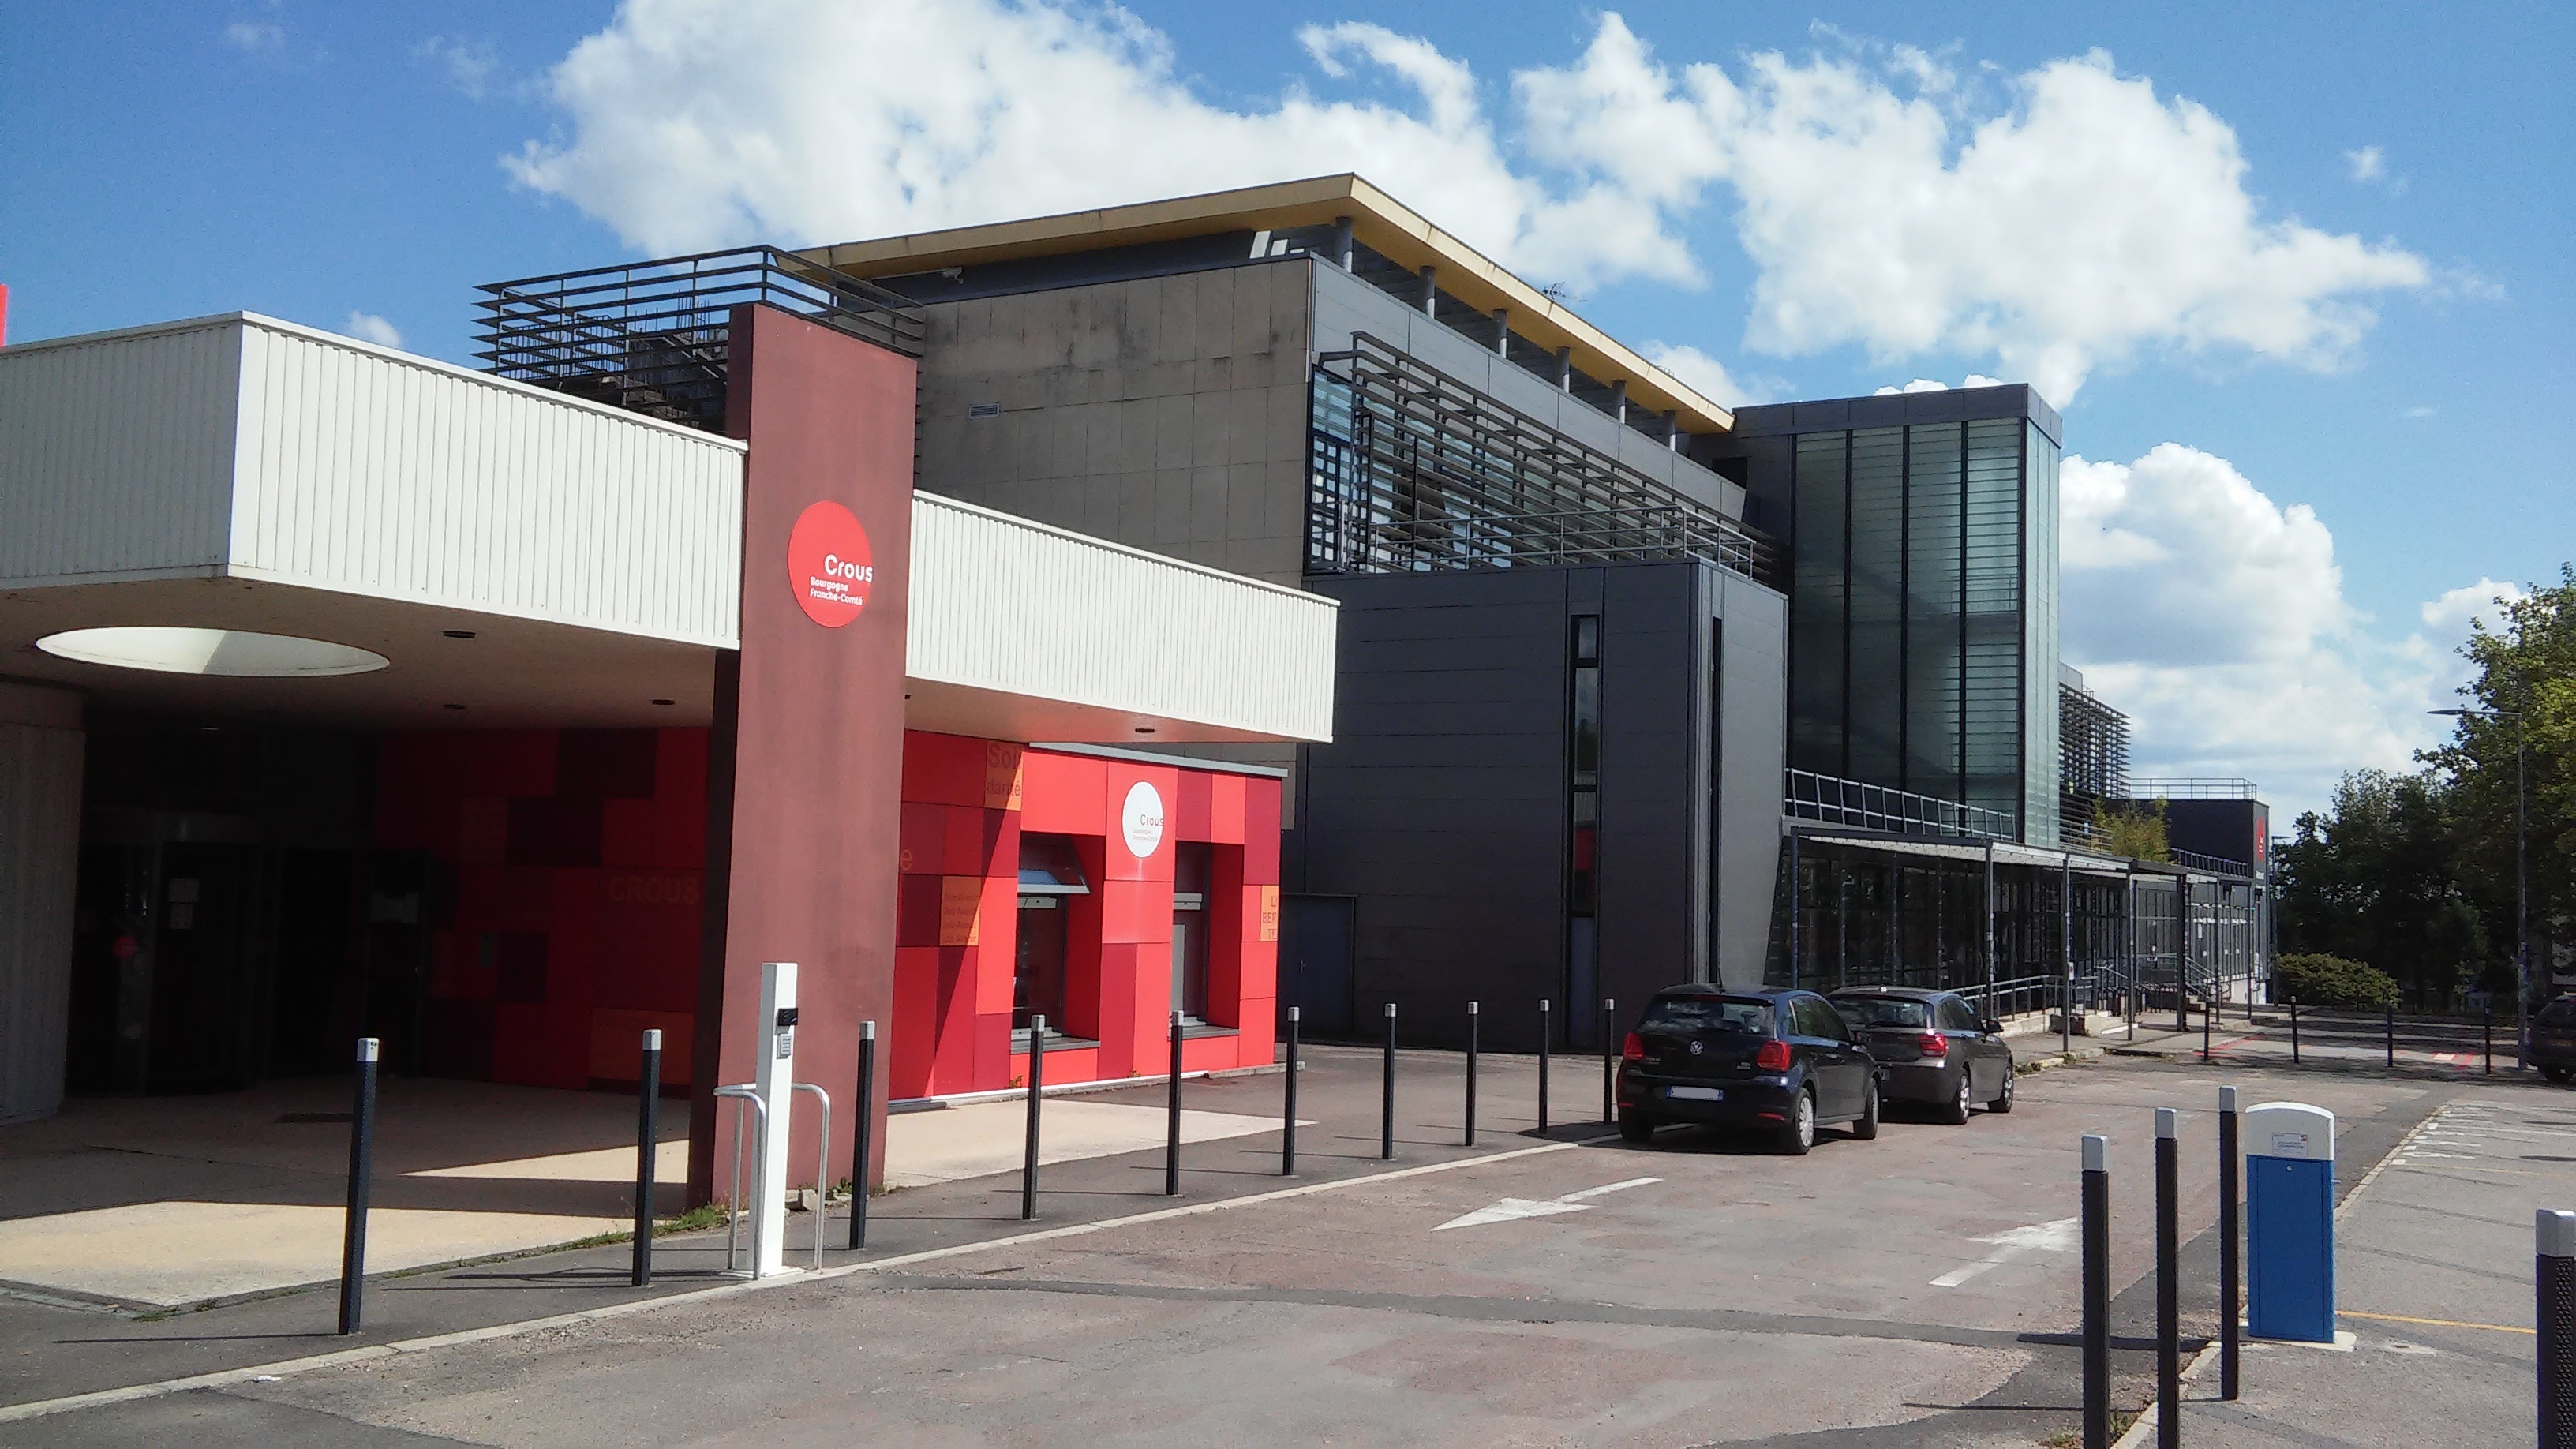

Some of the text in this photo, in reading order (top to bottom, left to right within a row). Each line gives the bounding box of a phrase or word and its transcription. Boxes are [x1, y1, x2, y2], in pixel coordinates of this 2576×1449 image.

[824, 554, 874, 583] Crous
[810, 576, 849, 593] Bourgogne
[810, 587, 863, 606] Franche-Comté
[1140, 814, 1164, 827] Crous
[609, 875, 698, 904] CROUS
[1262, 912, 1276, 923] BER
